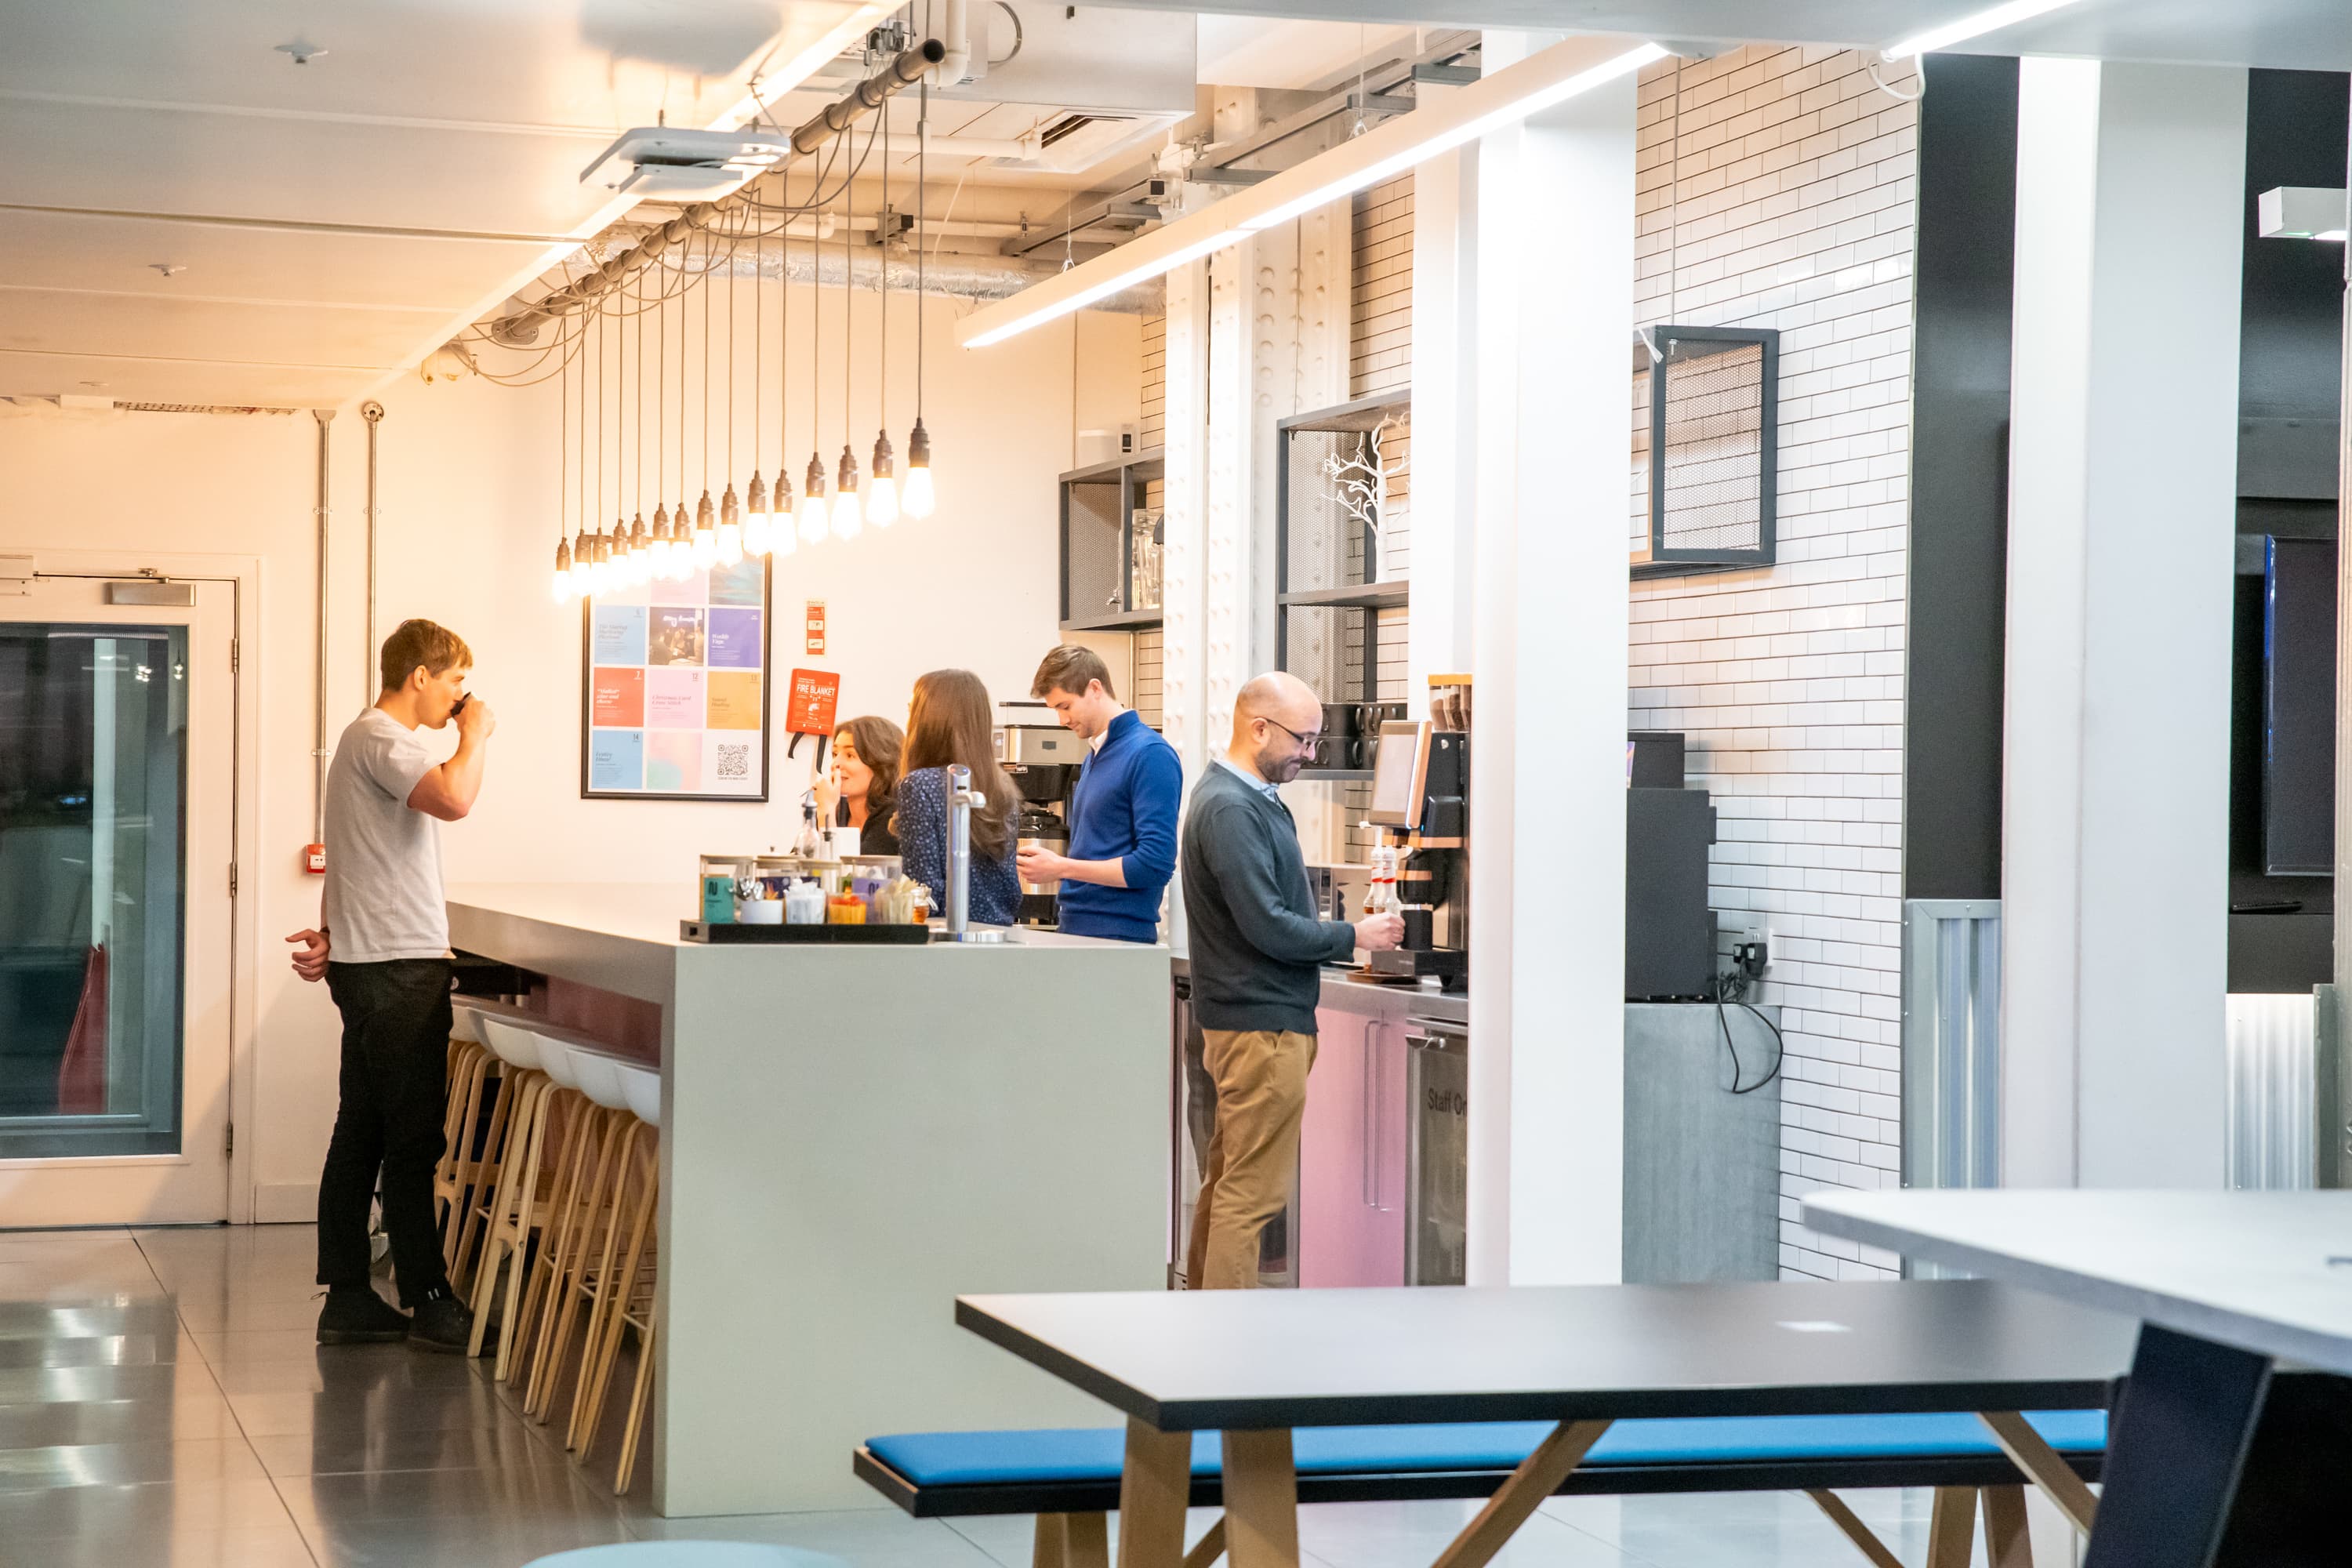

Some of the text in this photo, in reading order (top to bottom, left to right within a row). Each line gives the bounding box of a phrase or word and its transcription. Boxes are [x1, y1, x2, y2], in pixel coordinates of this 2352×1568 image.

[797, 684, 836, 696] FIRE BLANKET
[1428, 1088, 1467, 1116] Staff On
